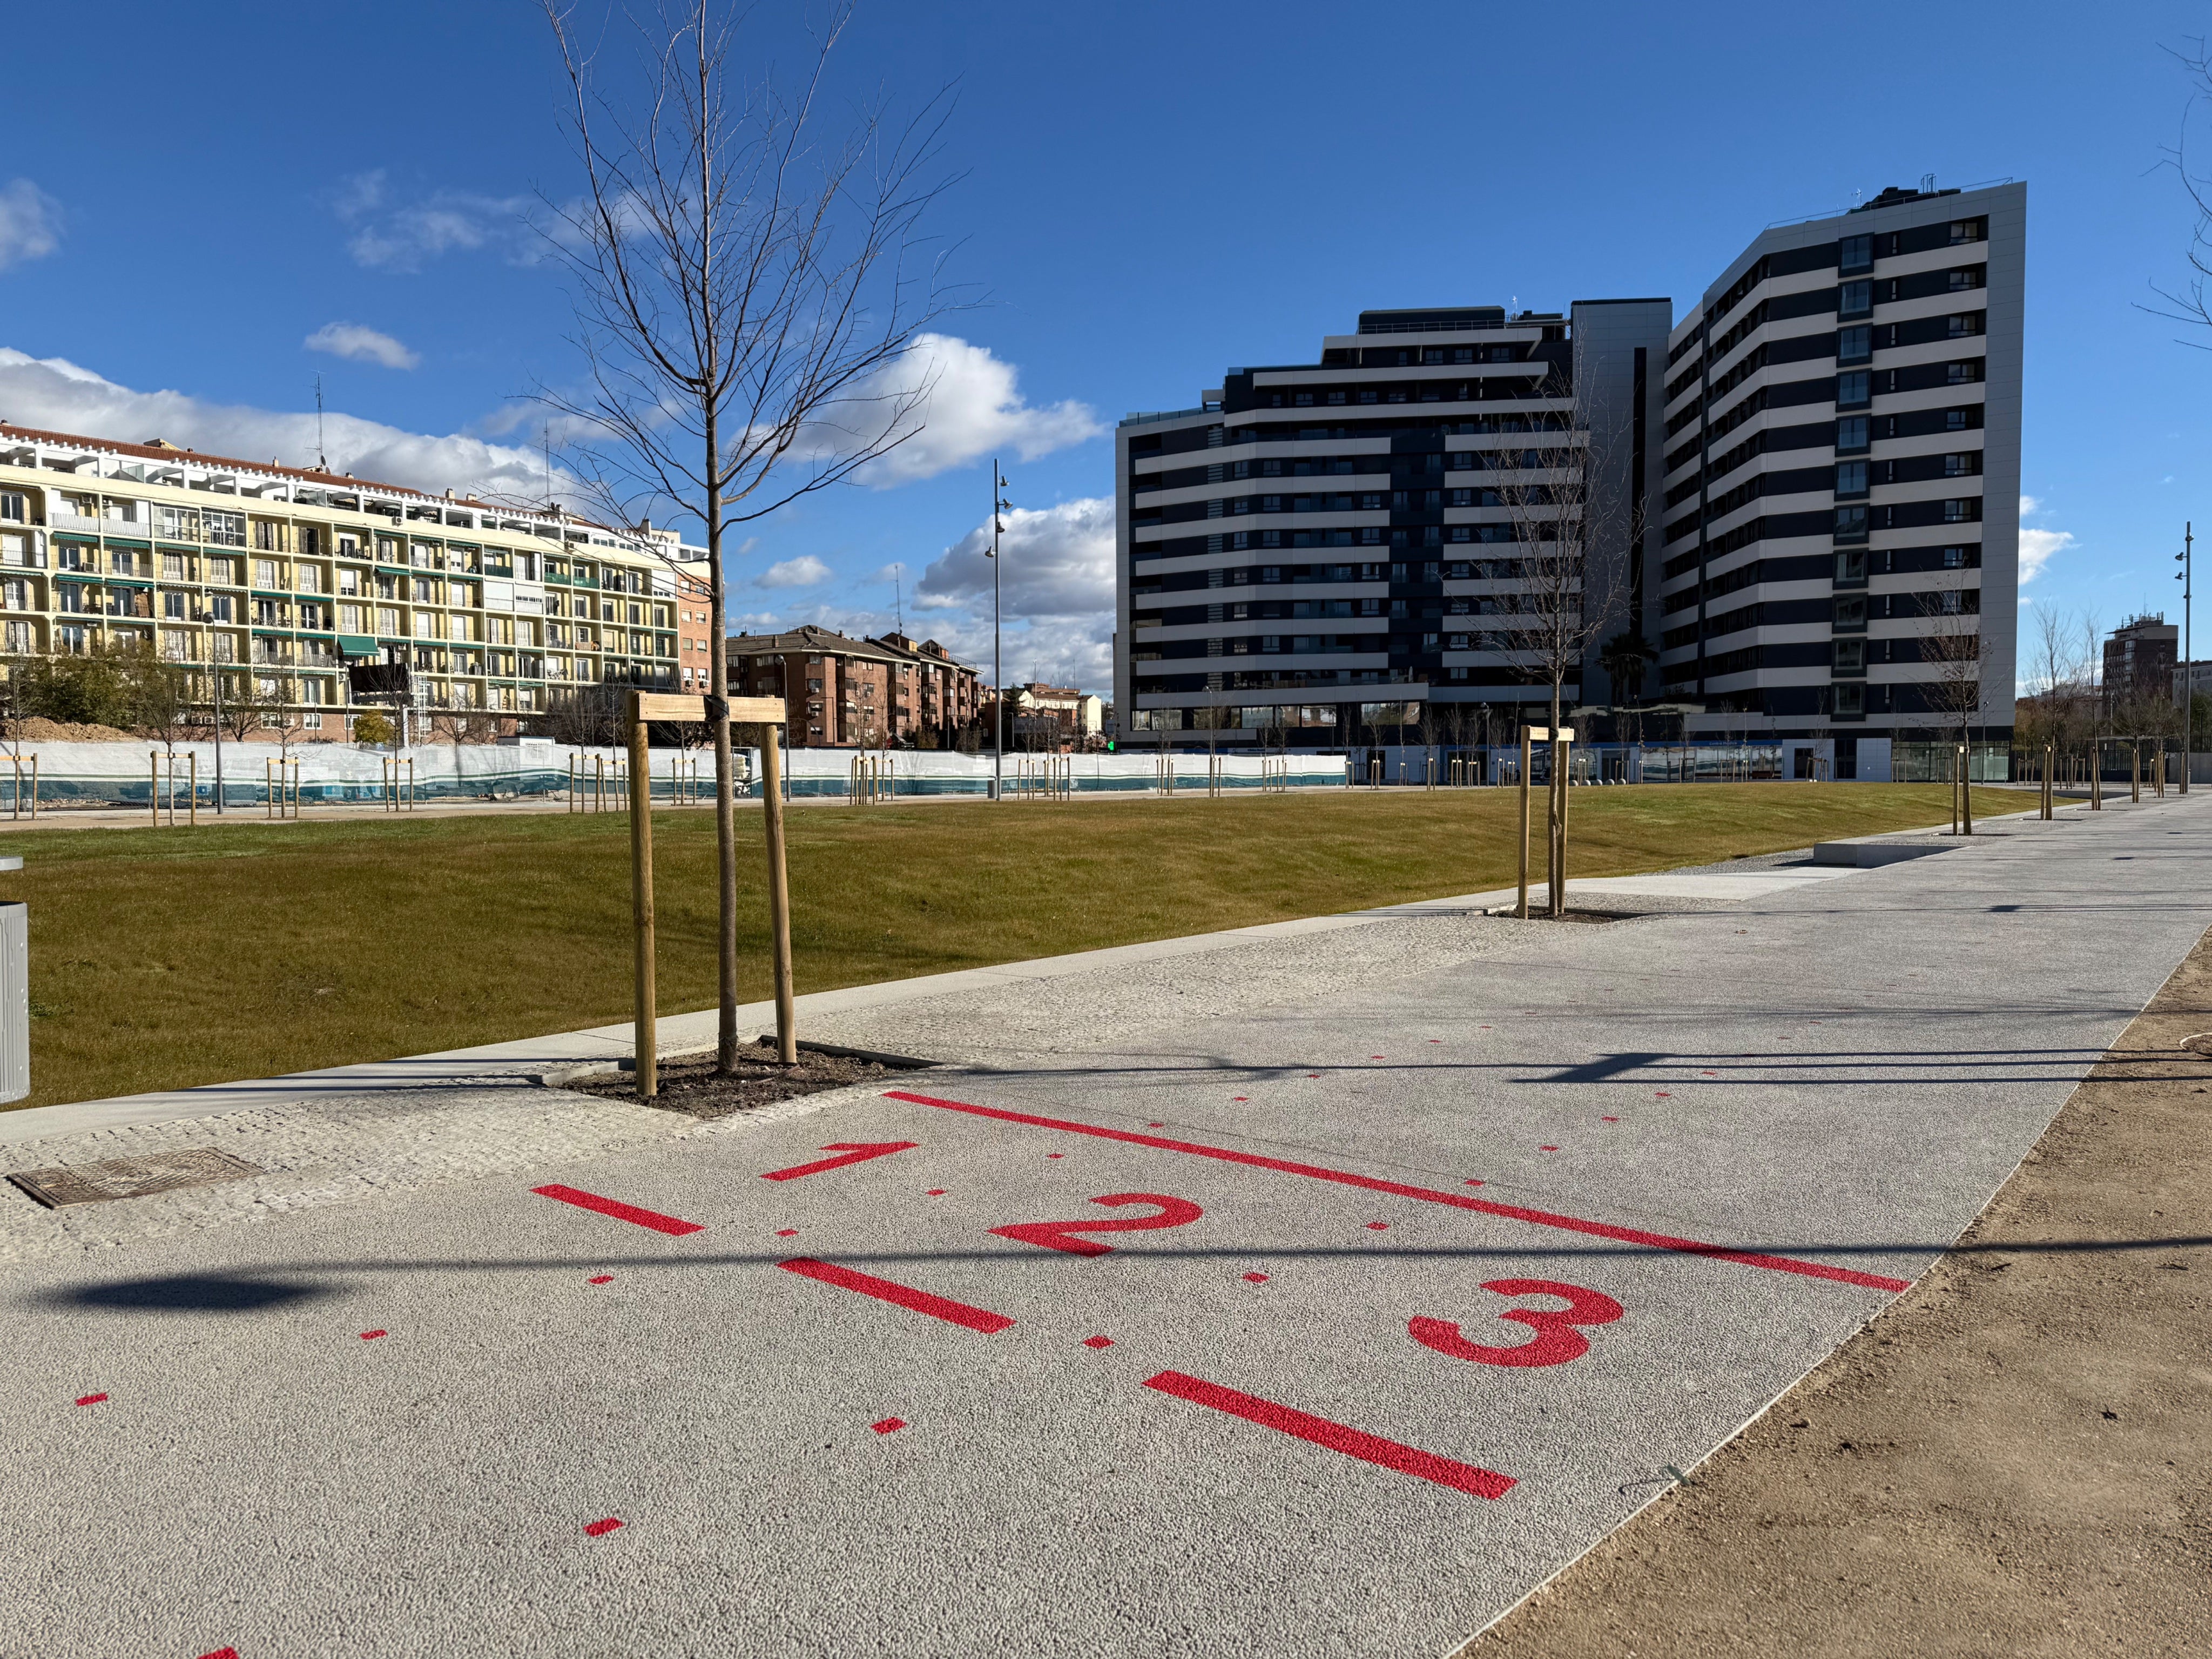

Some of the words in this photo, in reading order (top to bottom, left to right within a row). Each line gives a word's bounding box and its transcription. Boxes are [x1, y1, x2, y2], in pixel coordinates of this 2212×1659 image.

[760, 1141, 919, 1182] 1
[987, 1193, 1203, 1257] 2
[1408, 1278, 1623, 1367] 3
